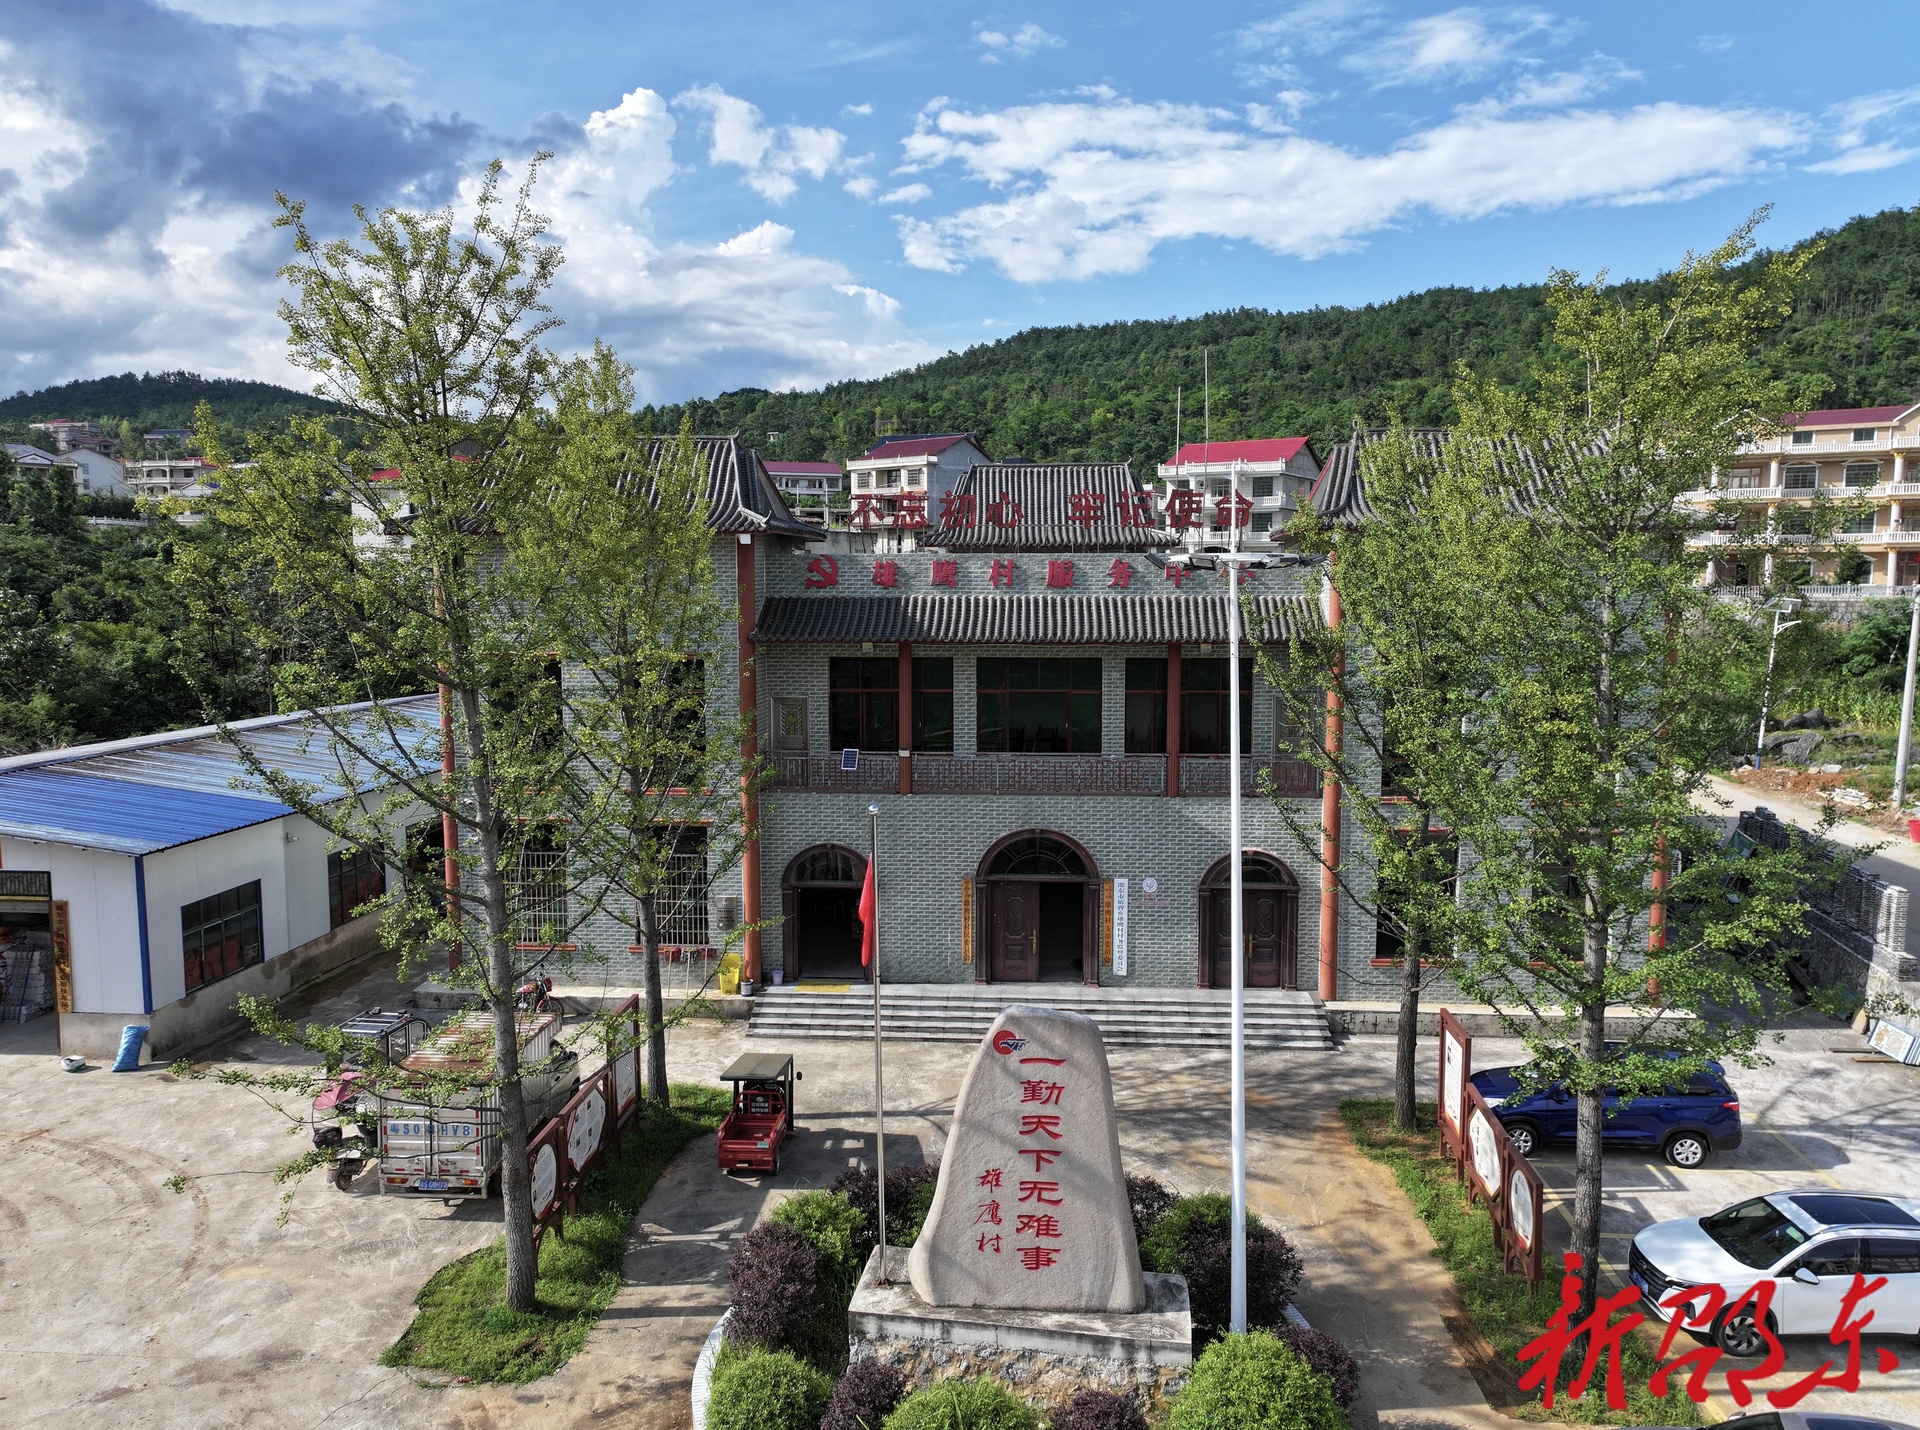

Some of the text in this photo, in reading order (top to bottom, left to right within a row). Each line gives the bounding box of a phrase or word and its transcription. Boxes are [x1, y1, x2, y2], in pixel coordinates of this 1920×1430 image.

[848, 489, 1255, 530] 不忘初心 牢记使命
[1016, 1057, 1067, 1270] 一勤天下无难事
[974, 1167, 1004, 1254] 雄鹰村
